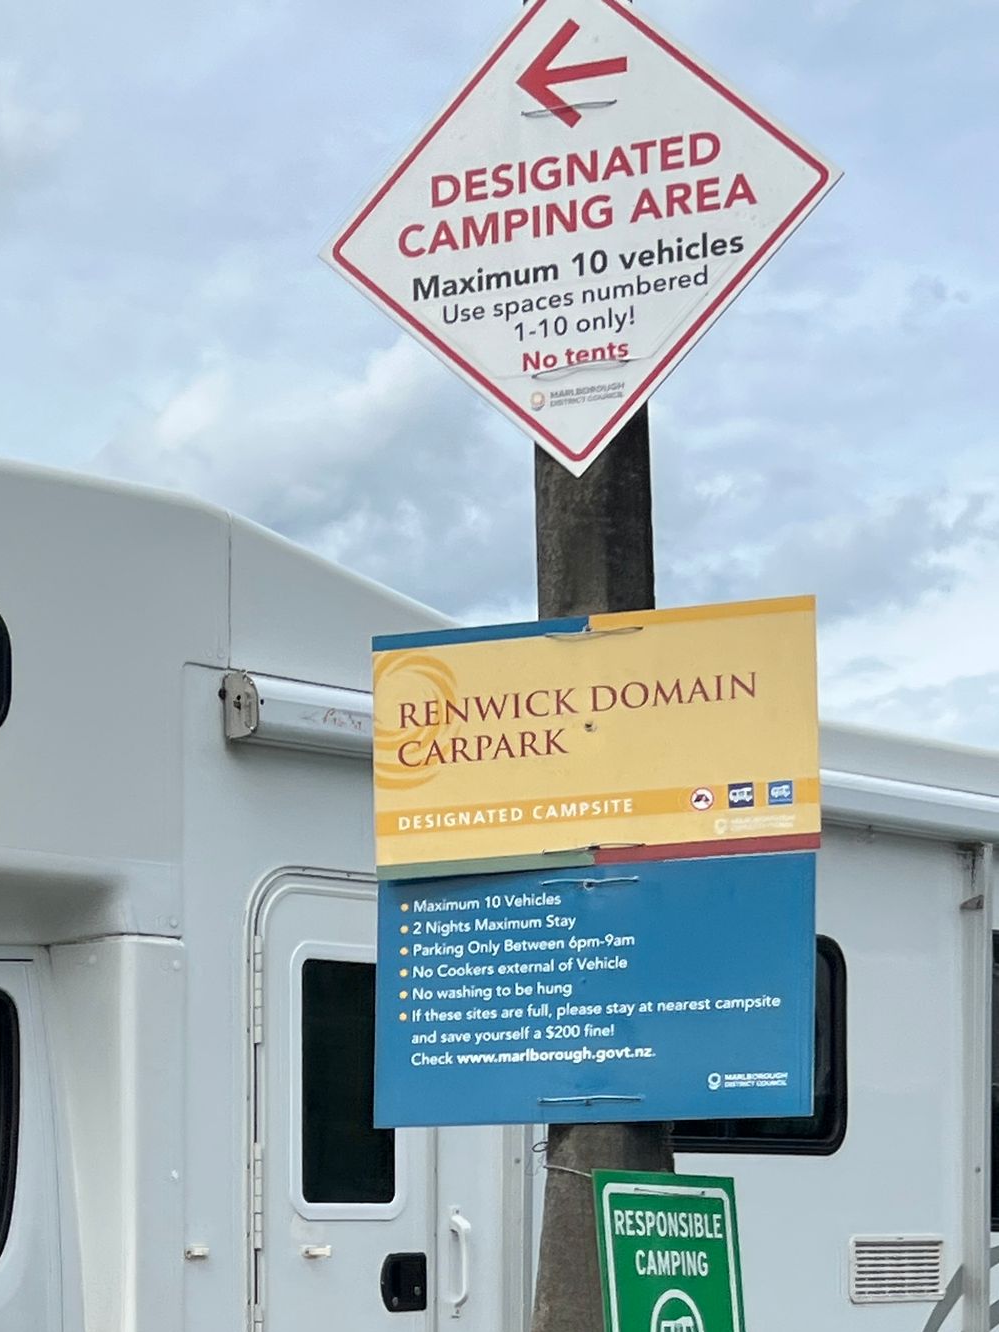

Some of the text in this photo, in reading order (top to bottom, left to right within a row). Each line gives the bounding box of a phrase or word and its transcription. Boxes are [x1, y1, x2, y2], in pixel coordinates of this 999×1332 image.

[430, 132, 721, 208] DESIGNATED
[398, 173, 758, 259] CAMPING AREA
[412, 233, 744, 301] Maximum 10 vehicles
[442, 266, 709, 325] Use spaces numbered
[514, 306, 636, 342] 1-10 only!
[522, 340, 629, 371] No tents
[550, 382, 625, 398] MARLBOROUGH
[399, 672, 758, 729] RENWICK DOMAIN
[397, 729, 568, 767] CARPARK
[399, 798, 633, 831] DESIGNATED CAMPSITE
[414, 893, 561, 913] Maximum 10 Vehicles
[413, 914, 576, 936] 2 Nights Maximum Stay
[413, 933, 635, 959] Parking Only Between 6pm-9am
[412, 956, 628, 977] No Cookers external of Vehicle
[412, 982, 573, 1001] No washing to be hung
[411, 994, 781, 1022] If these sites are full, please stay at nearest campsite
[411, 1023, 614, 1045] and save yourself a $200 fine!
[411, 1052, 454, 1066] Check
[725, 1072, 788, 1080] MARLBOROUGH
[614, 1209, 723, 1239] RESPONSIBLE
[635, 1250, 709, 1277] CAMPING
